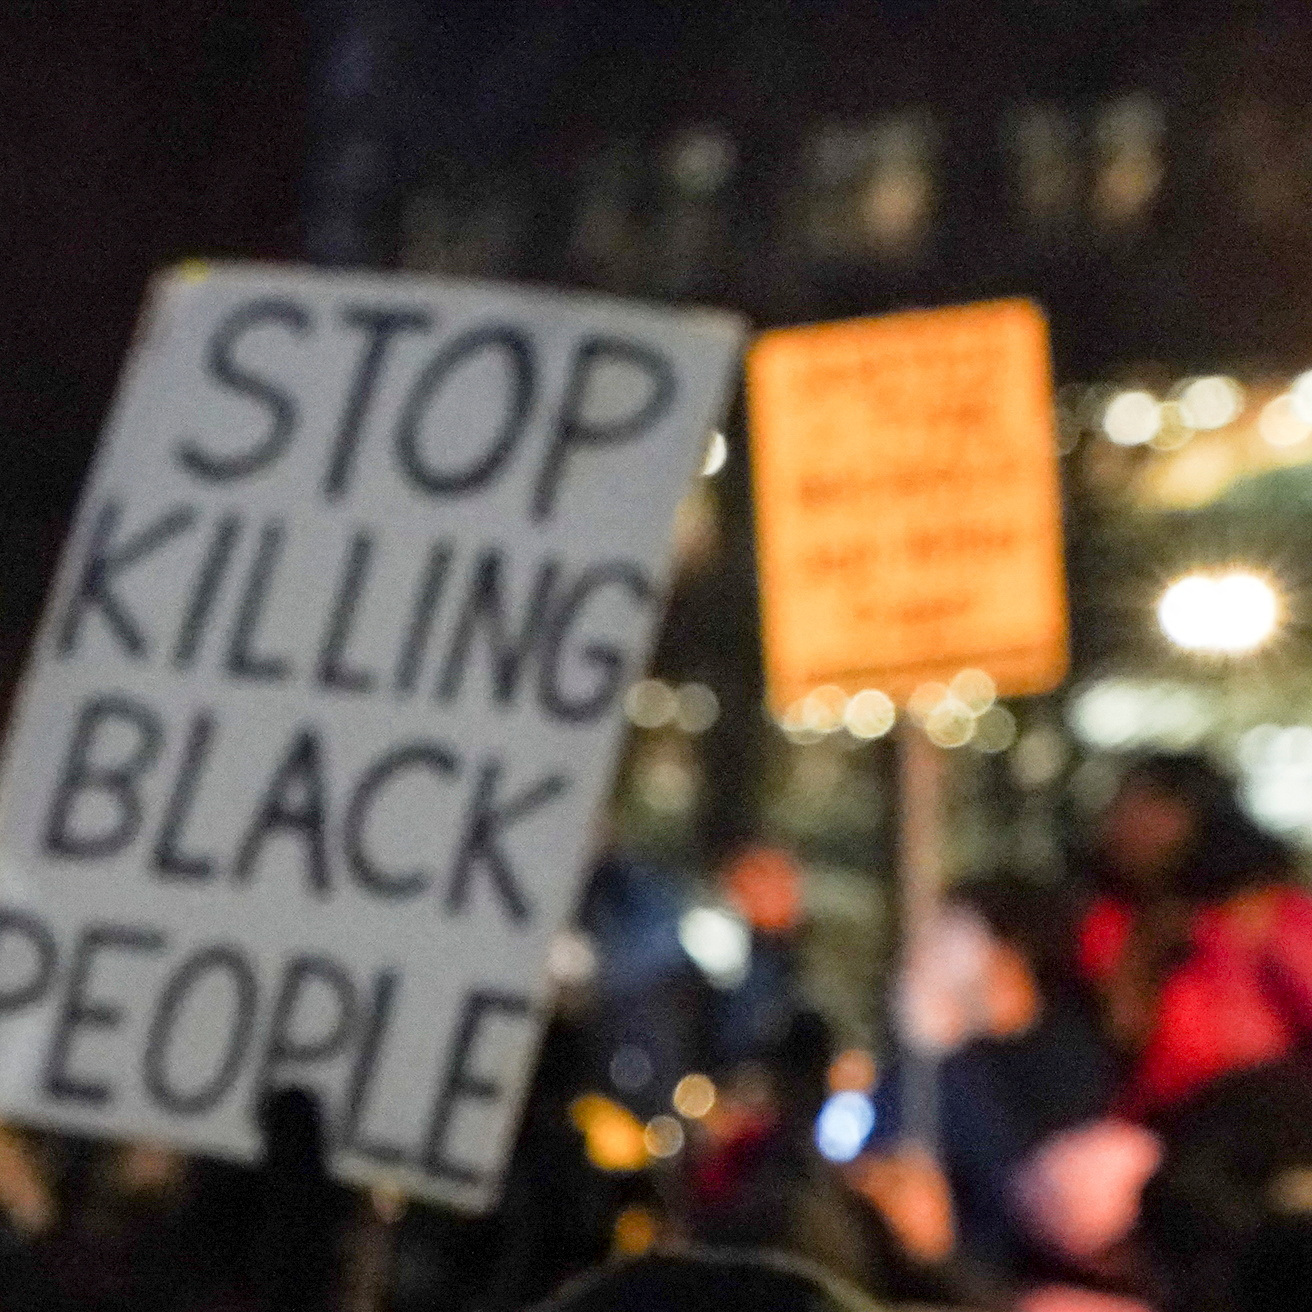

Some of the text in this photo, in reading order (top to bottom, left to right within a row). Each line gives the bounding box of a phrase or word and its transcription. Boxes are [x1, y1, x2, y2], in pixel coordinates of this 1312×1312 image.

[175, 296, 677, 522] STOP
[52, 498, 652, 728] KILLING
[42, 692, 566, 926] BLACK
